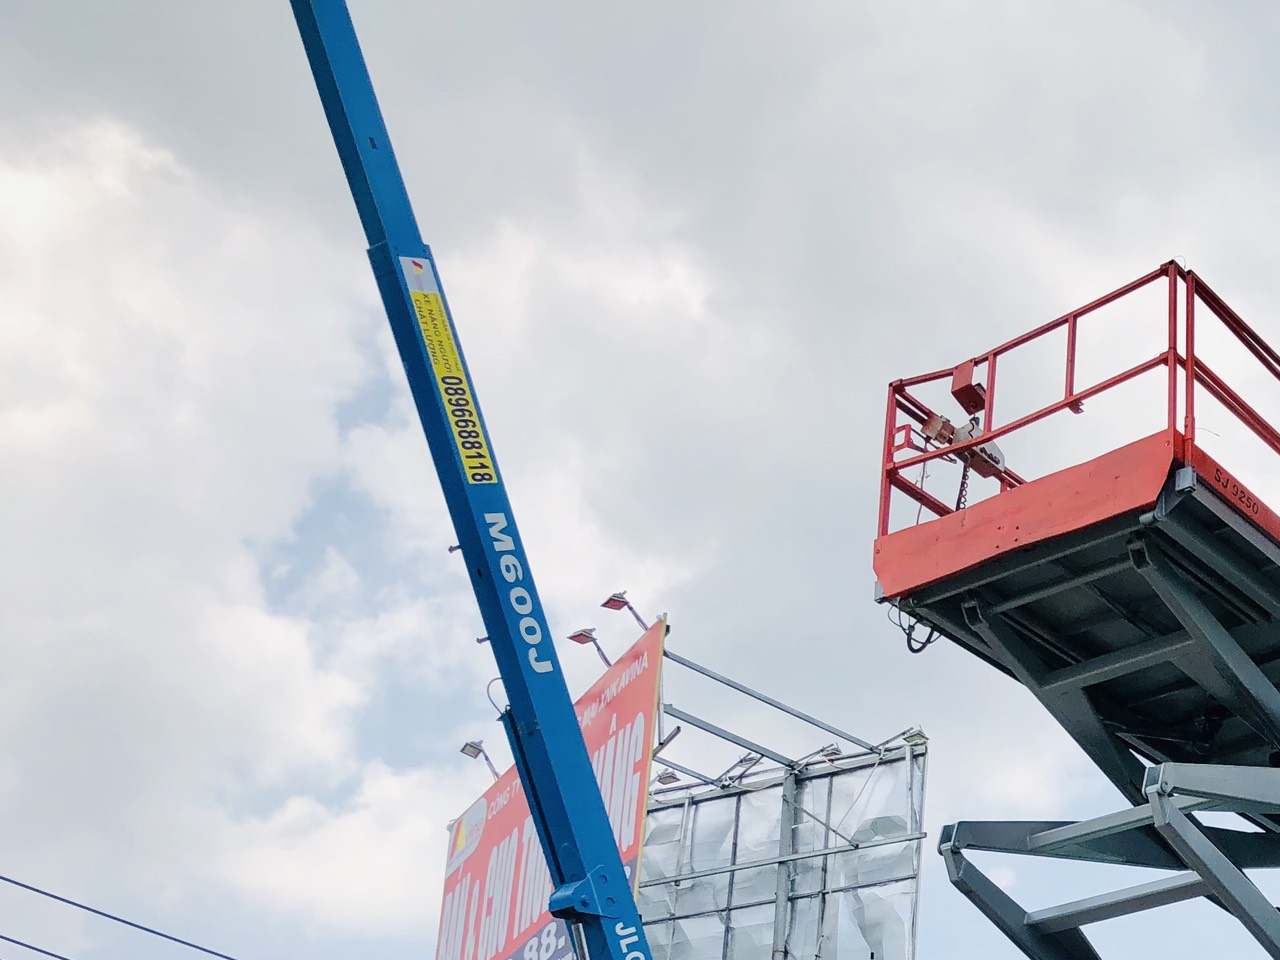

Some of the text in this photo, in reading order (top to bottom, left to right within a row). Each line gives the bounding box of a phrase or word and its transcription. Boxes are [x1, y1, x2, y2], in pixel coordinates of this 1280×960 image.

[440, 375, 493, 483] 0896688118
[1214, 468, 1259, 514] SJ 9250
[483, 512, 554, 674] M600J
